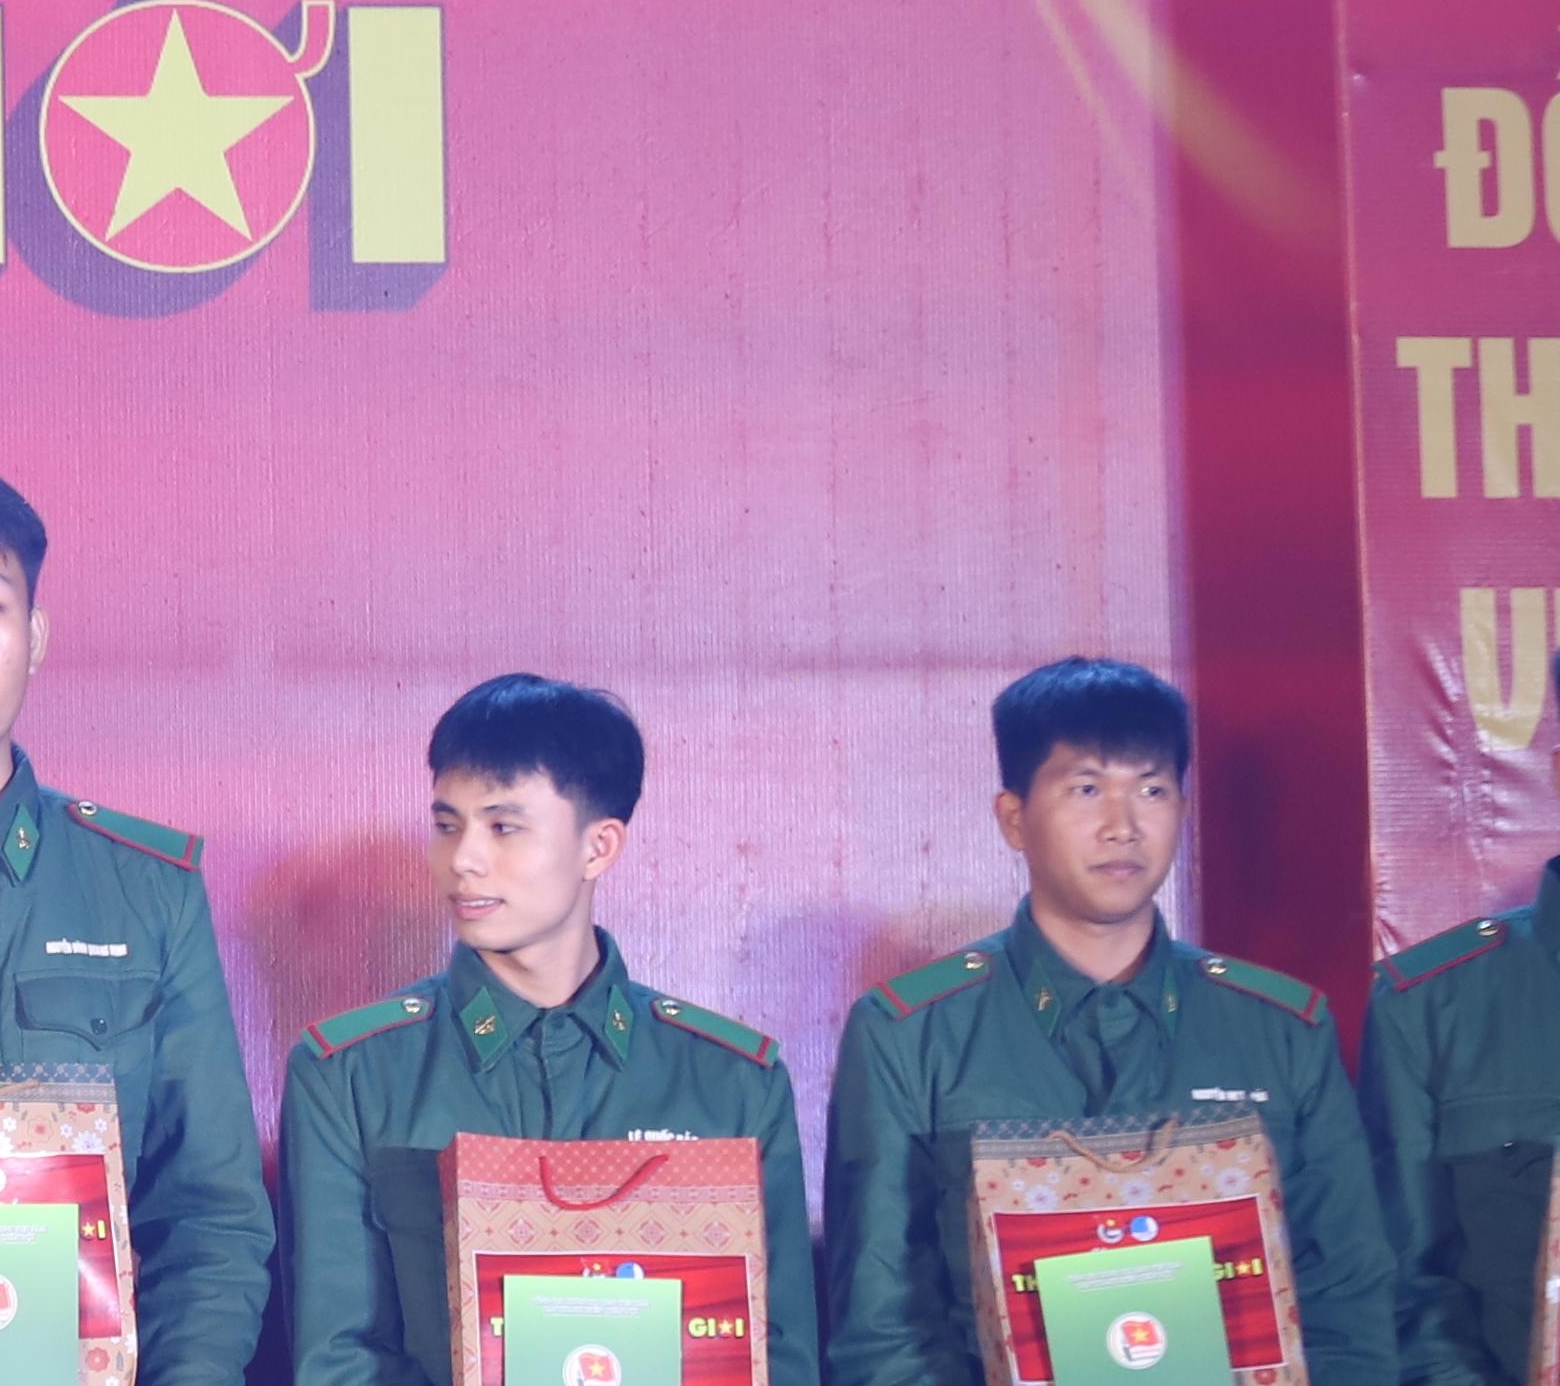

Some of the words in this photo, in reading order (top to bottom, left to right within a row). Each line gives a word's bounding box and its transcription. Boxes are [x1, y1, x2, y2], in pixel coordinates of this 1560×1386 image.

[1433, 85, 1560, 250] Đ
[1396, 336, 1560, 499] TH
[1459, 586, 1560, 750] U
